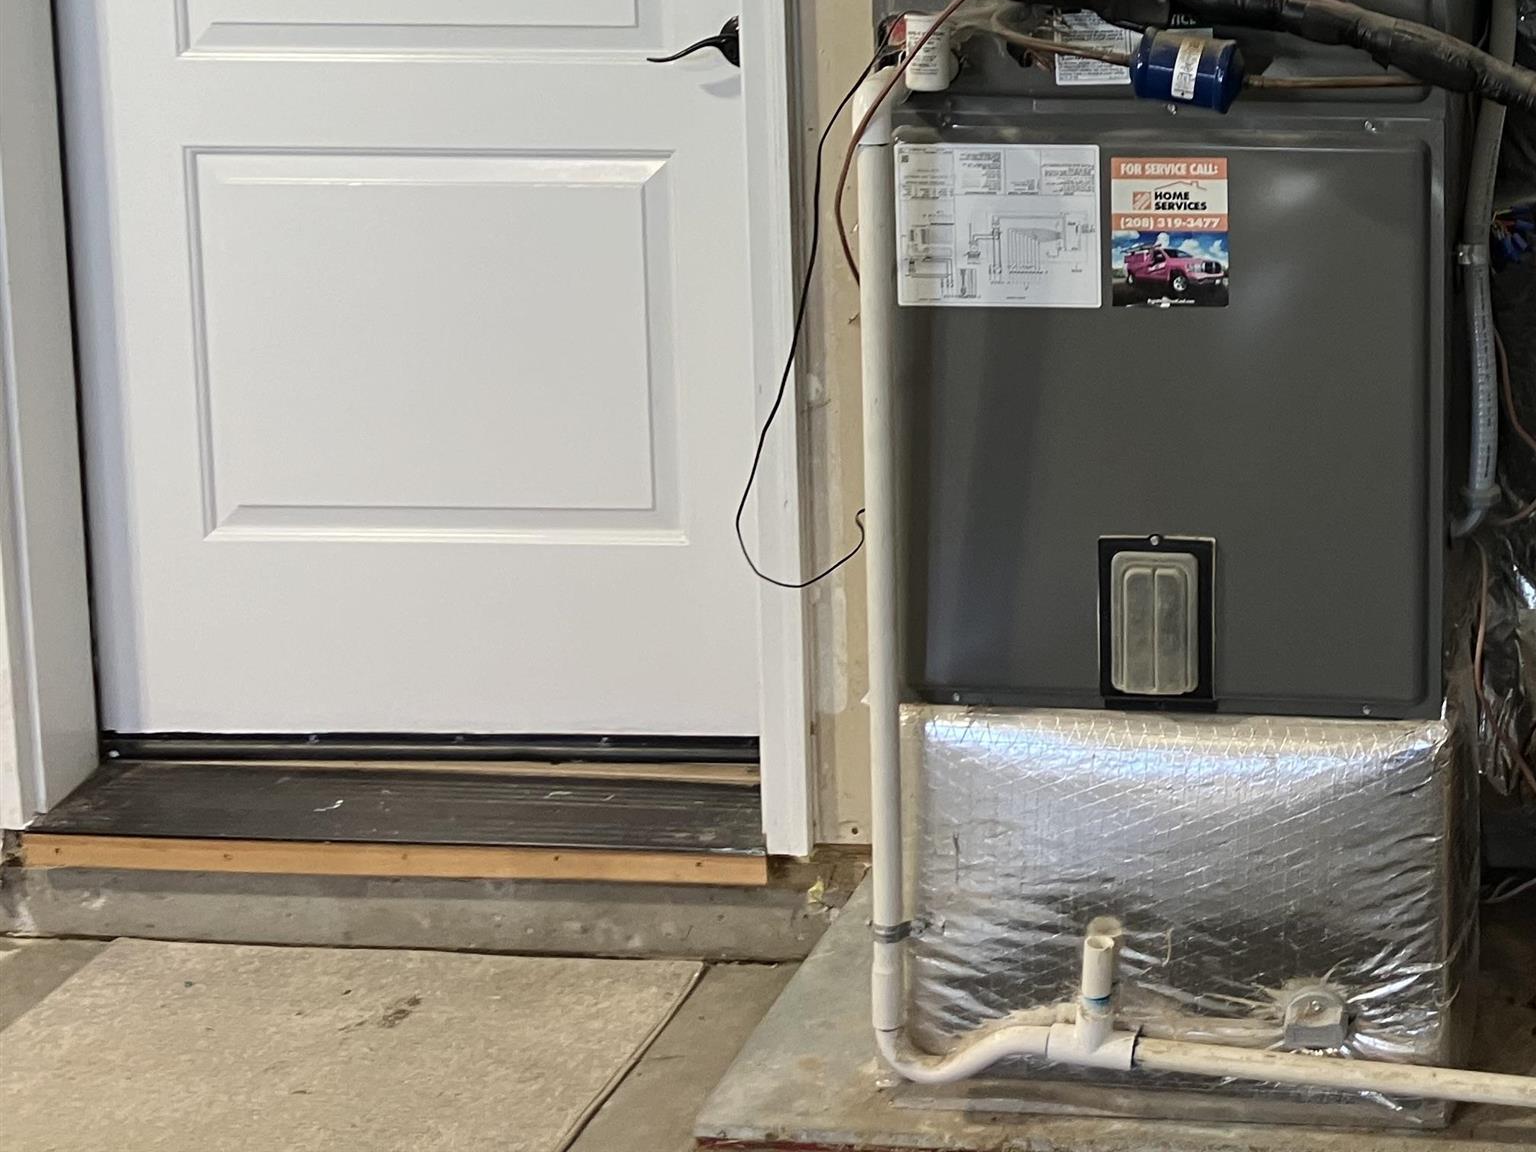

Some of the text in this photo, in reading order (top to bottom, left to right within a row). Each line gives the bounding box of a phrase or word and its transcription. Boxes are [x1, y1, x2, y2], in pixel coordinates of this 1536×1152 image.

[1120, 163, 1219, 175] FOR SERVICE CALL:
[1154, 191, 1190, 201] HOME
[1154, 201, 1208, 211] SERVICES
[1120, 217, 1221, 229] (208) 319-3477
